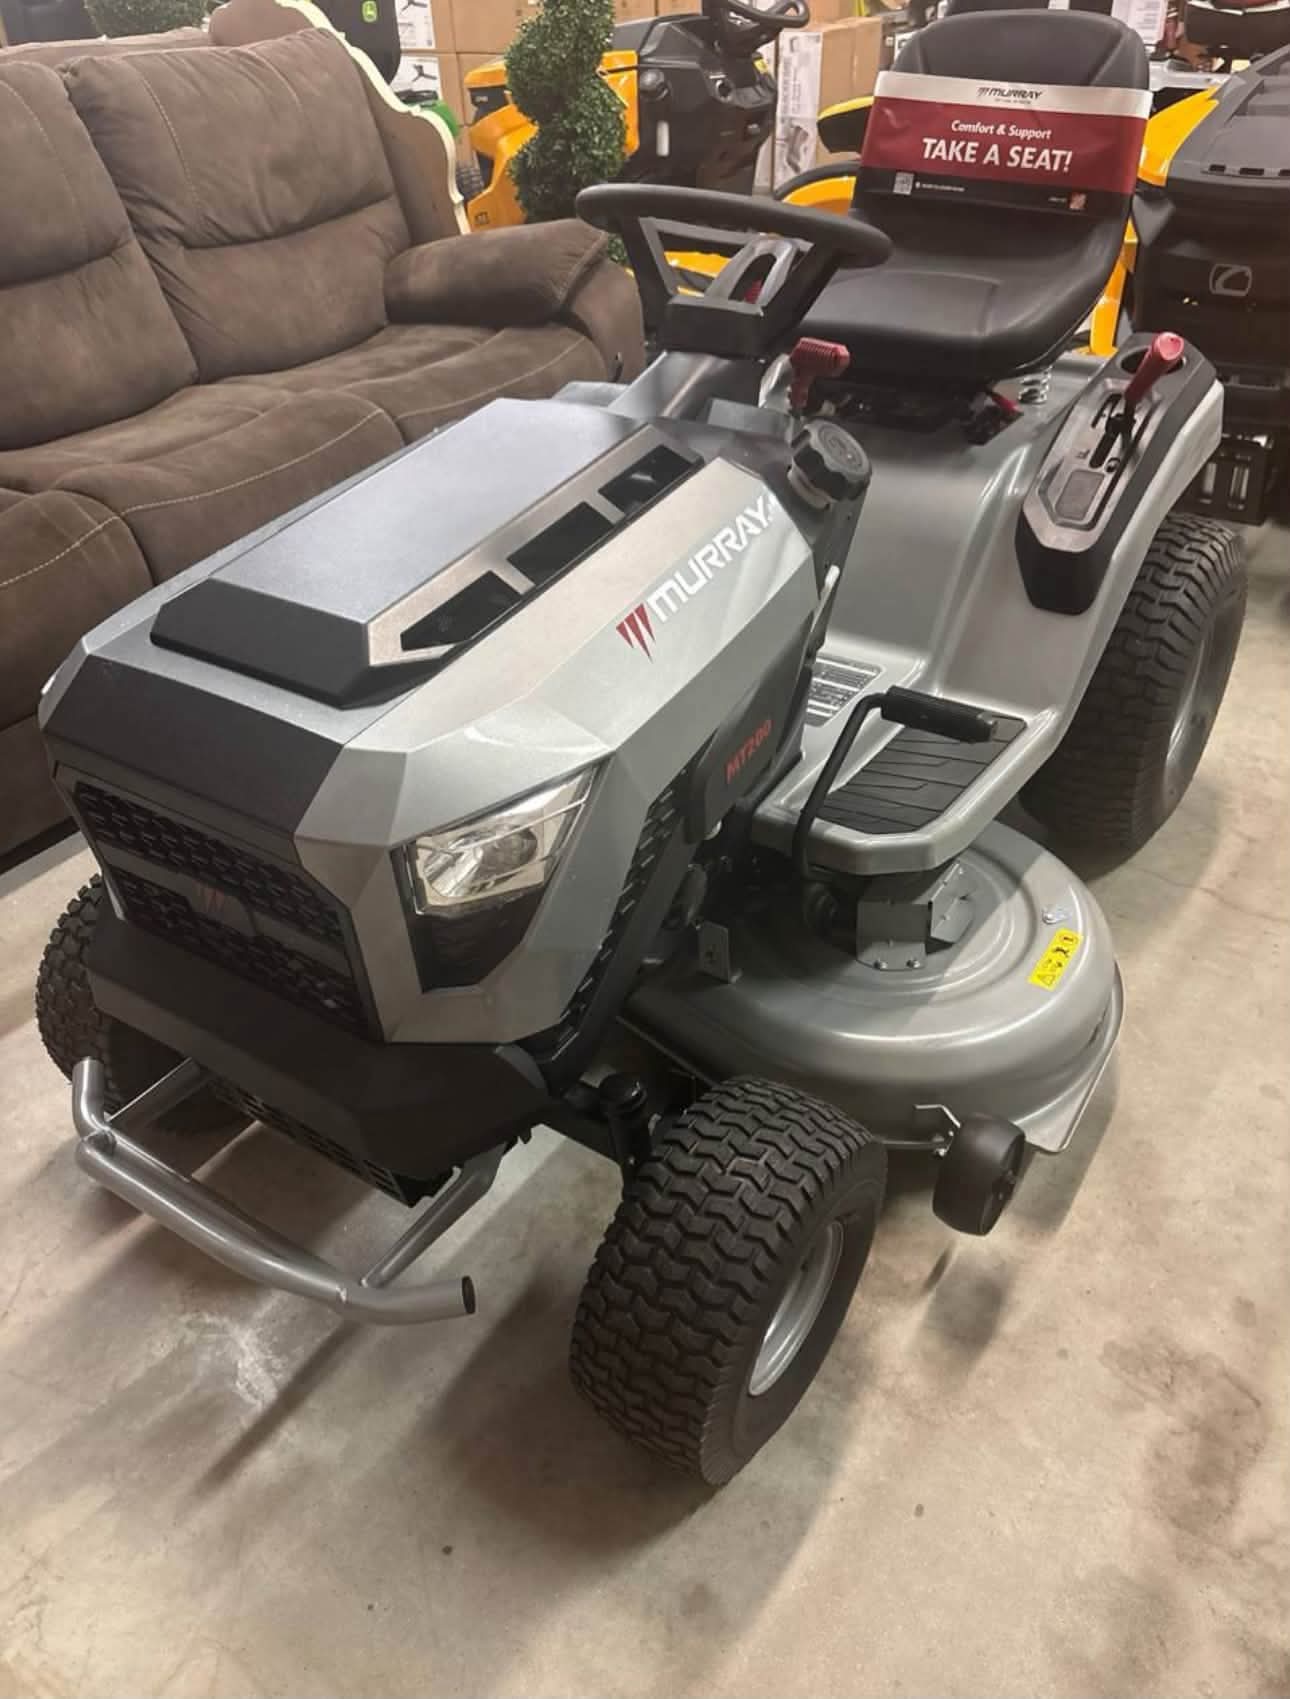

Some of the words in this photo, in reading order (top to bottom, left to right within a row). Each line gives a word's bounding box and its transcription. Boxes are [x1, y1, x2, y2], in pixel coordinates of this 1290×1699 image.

[988, 88, 1043, 100] MURRAY
[951, 120, 994, 135] Comfort
[996, 124, 1006, 136] &
[1008, 125, 1052, 140] Support
[922, 138, 979, 163] TAKE
[983, 143, 1000, 166] A
[1006, 145, 1073, 173] SEAT!
[646, 495, 769, 623] MURRAY
